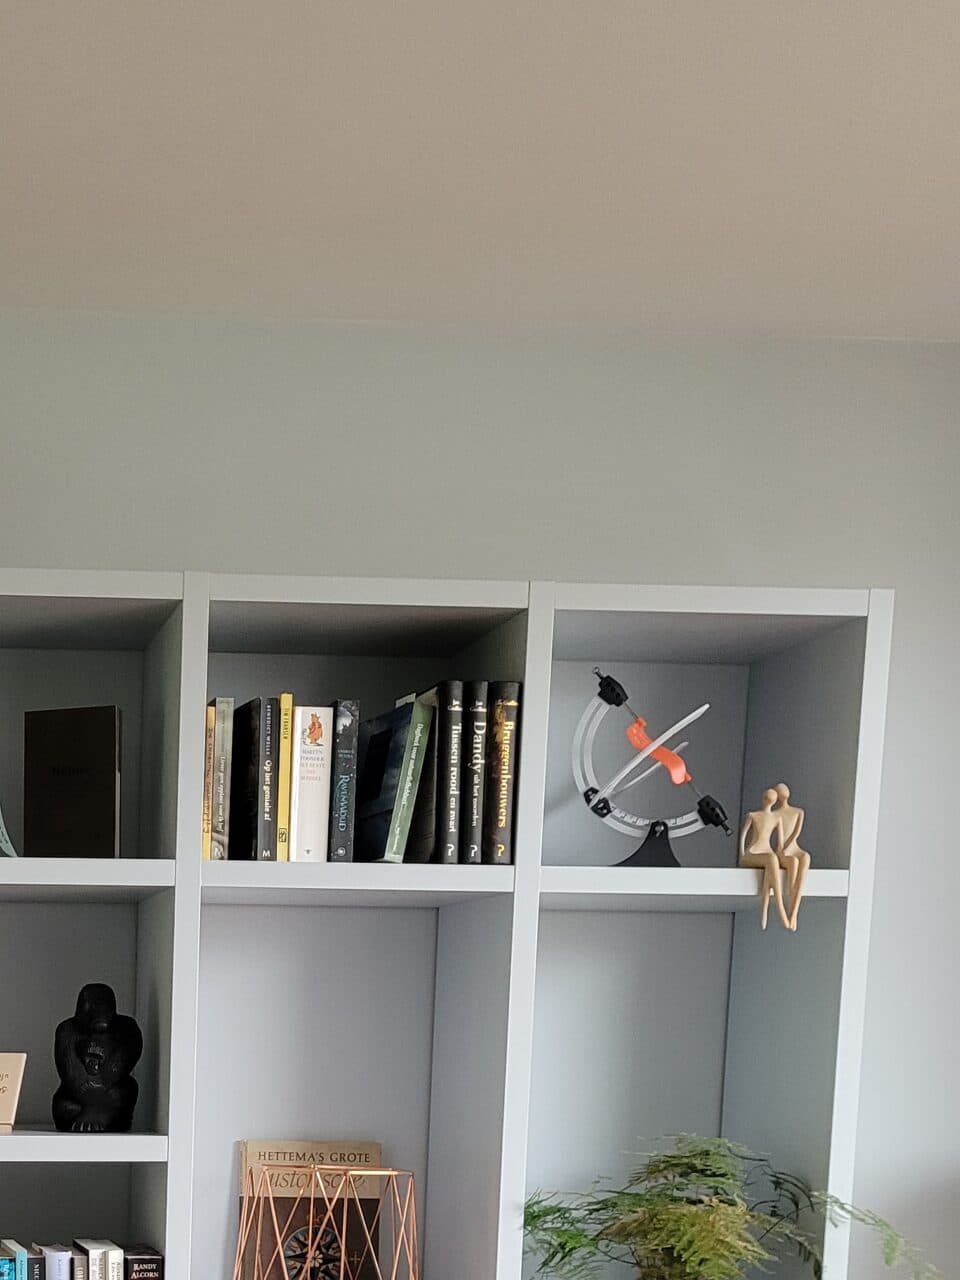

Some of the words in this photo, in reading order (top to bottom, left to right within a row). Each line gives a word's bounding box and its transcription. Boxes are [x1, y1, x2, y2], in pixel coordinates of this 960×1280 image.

[450, 723, 462, 763] Tussen
[467, 722, 487, 772] Dandy
[264, 759, 273, 770] Op
[449, 766, 460, 794] rood
[497, 721, 515, 828] Bruggenbouwers
[472, 785, 480, 796] het
[263, 785, 272, 810] geniale
[449, 797, 456, 808] en
[265, 812, 272, 821] af
[258, 1151, 324, 1163] HETTEMA'S
[329, 1152, 371, 1163] GROTE
[131, 1271, 159, 1280] ALCORN
